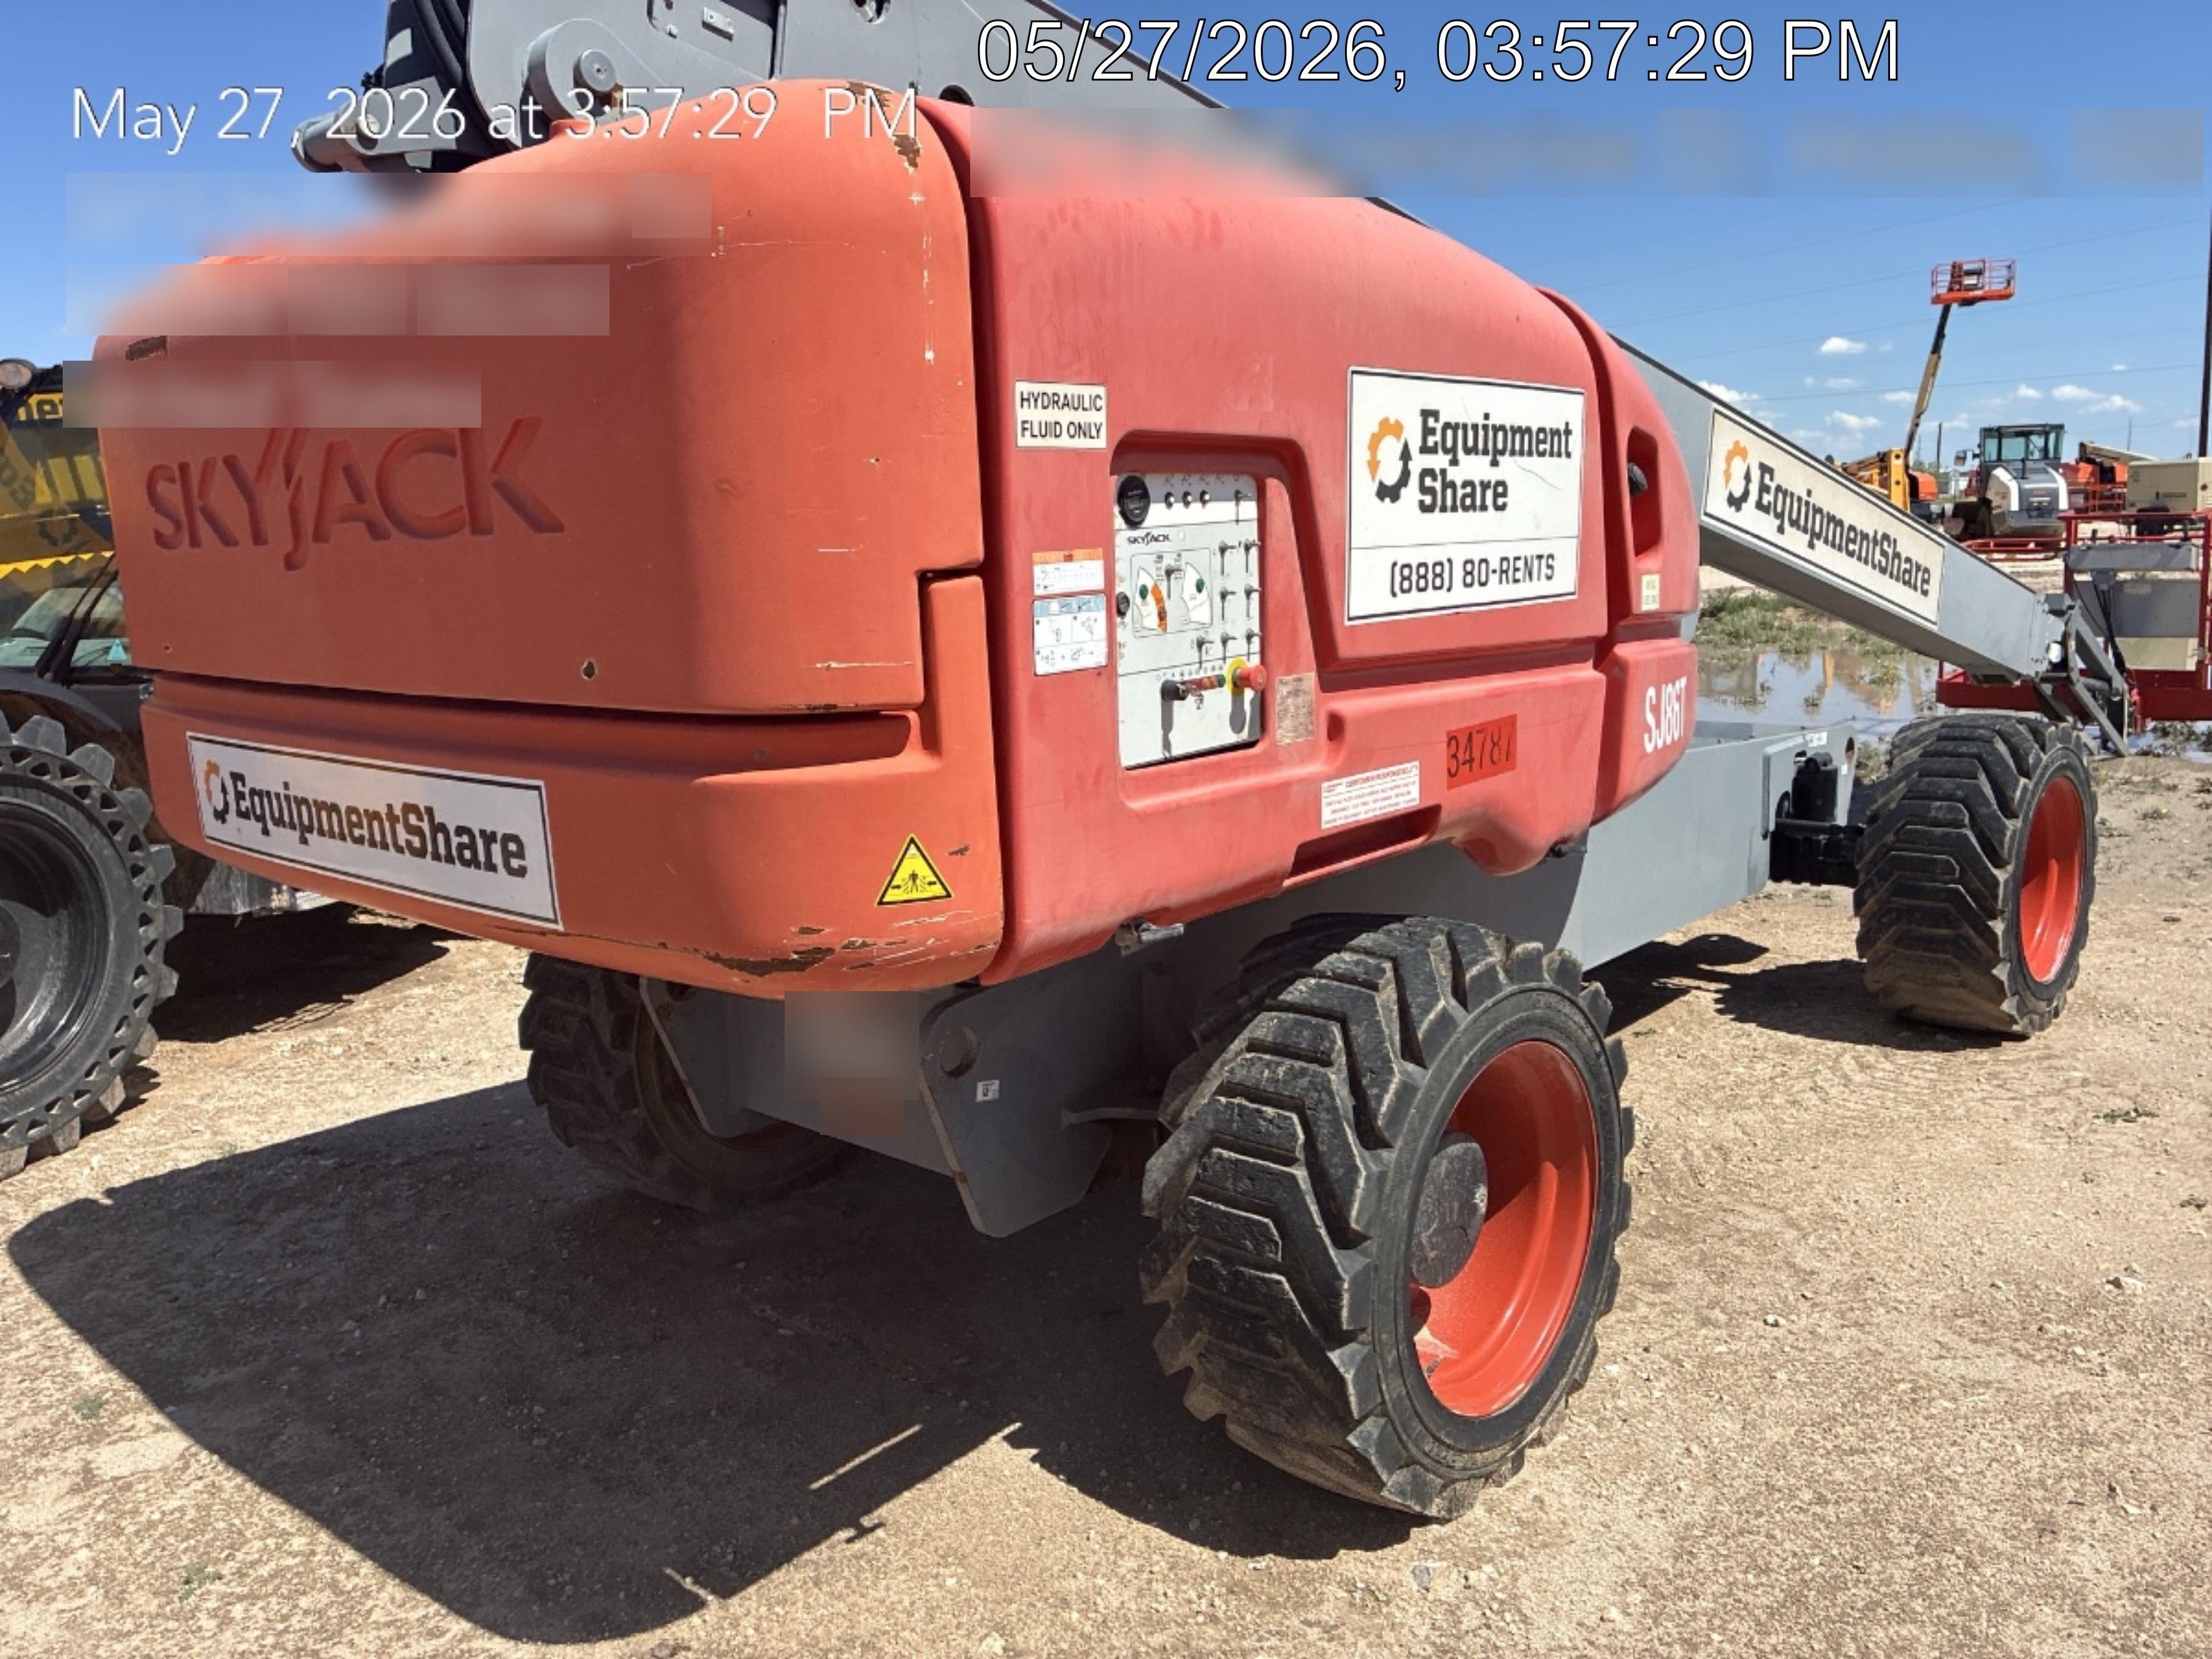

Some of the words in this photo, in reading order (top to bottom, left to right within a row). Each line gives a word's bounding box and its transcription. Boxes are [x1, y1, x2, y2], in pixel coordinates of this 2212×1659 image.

[1020, 390, 1103, 412] HYDRAULIC
[1021, 419, 1063, 439] FLUID
[1067, 420, 1103, 439] ONLY
[1419, 409, 1573, 467] Equipment
[146, 415, 565, 572] SKYJACK
[1418, 468, 1508, 514] Share
[1755, 461, 1931, 598] EquipmentShare
[1390, 558, 1453, 597] (888)
[1462, 553, 1555, 589] 80-RENTS
[1644, 676, 1687, 753] SJ86T
[229, 771, 528, 879] EquipmentShare
